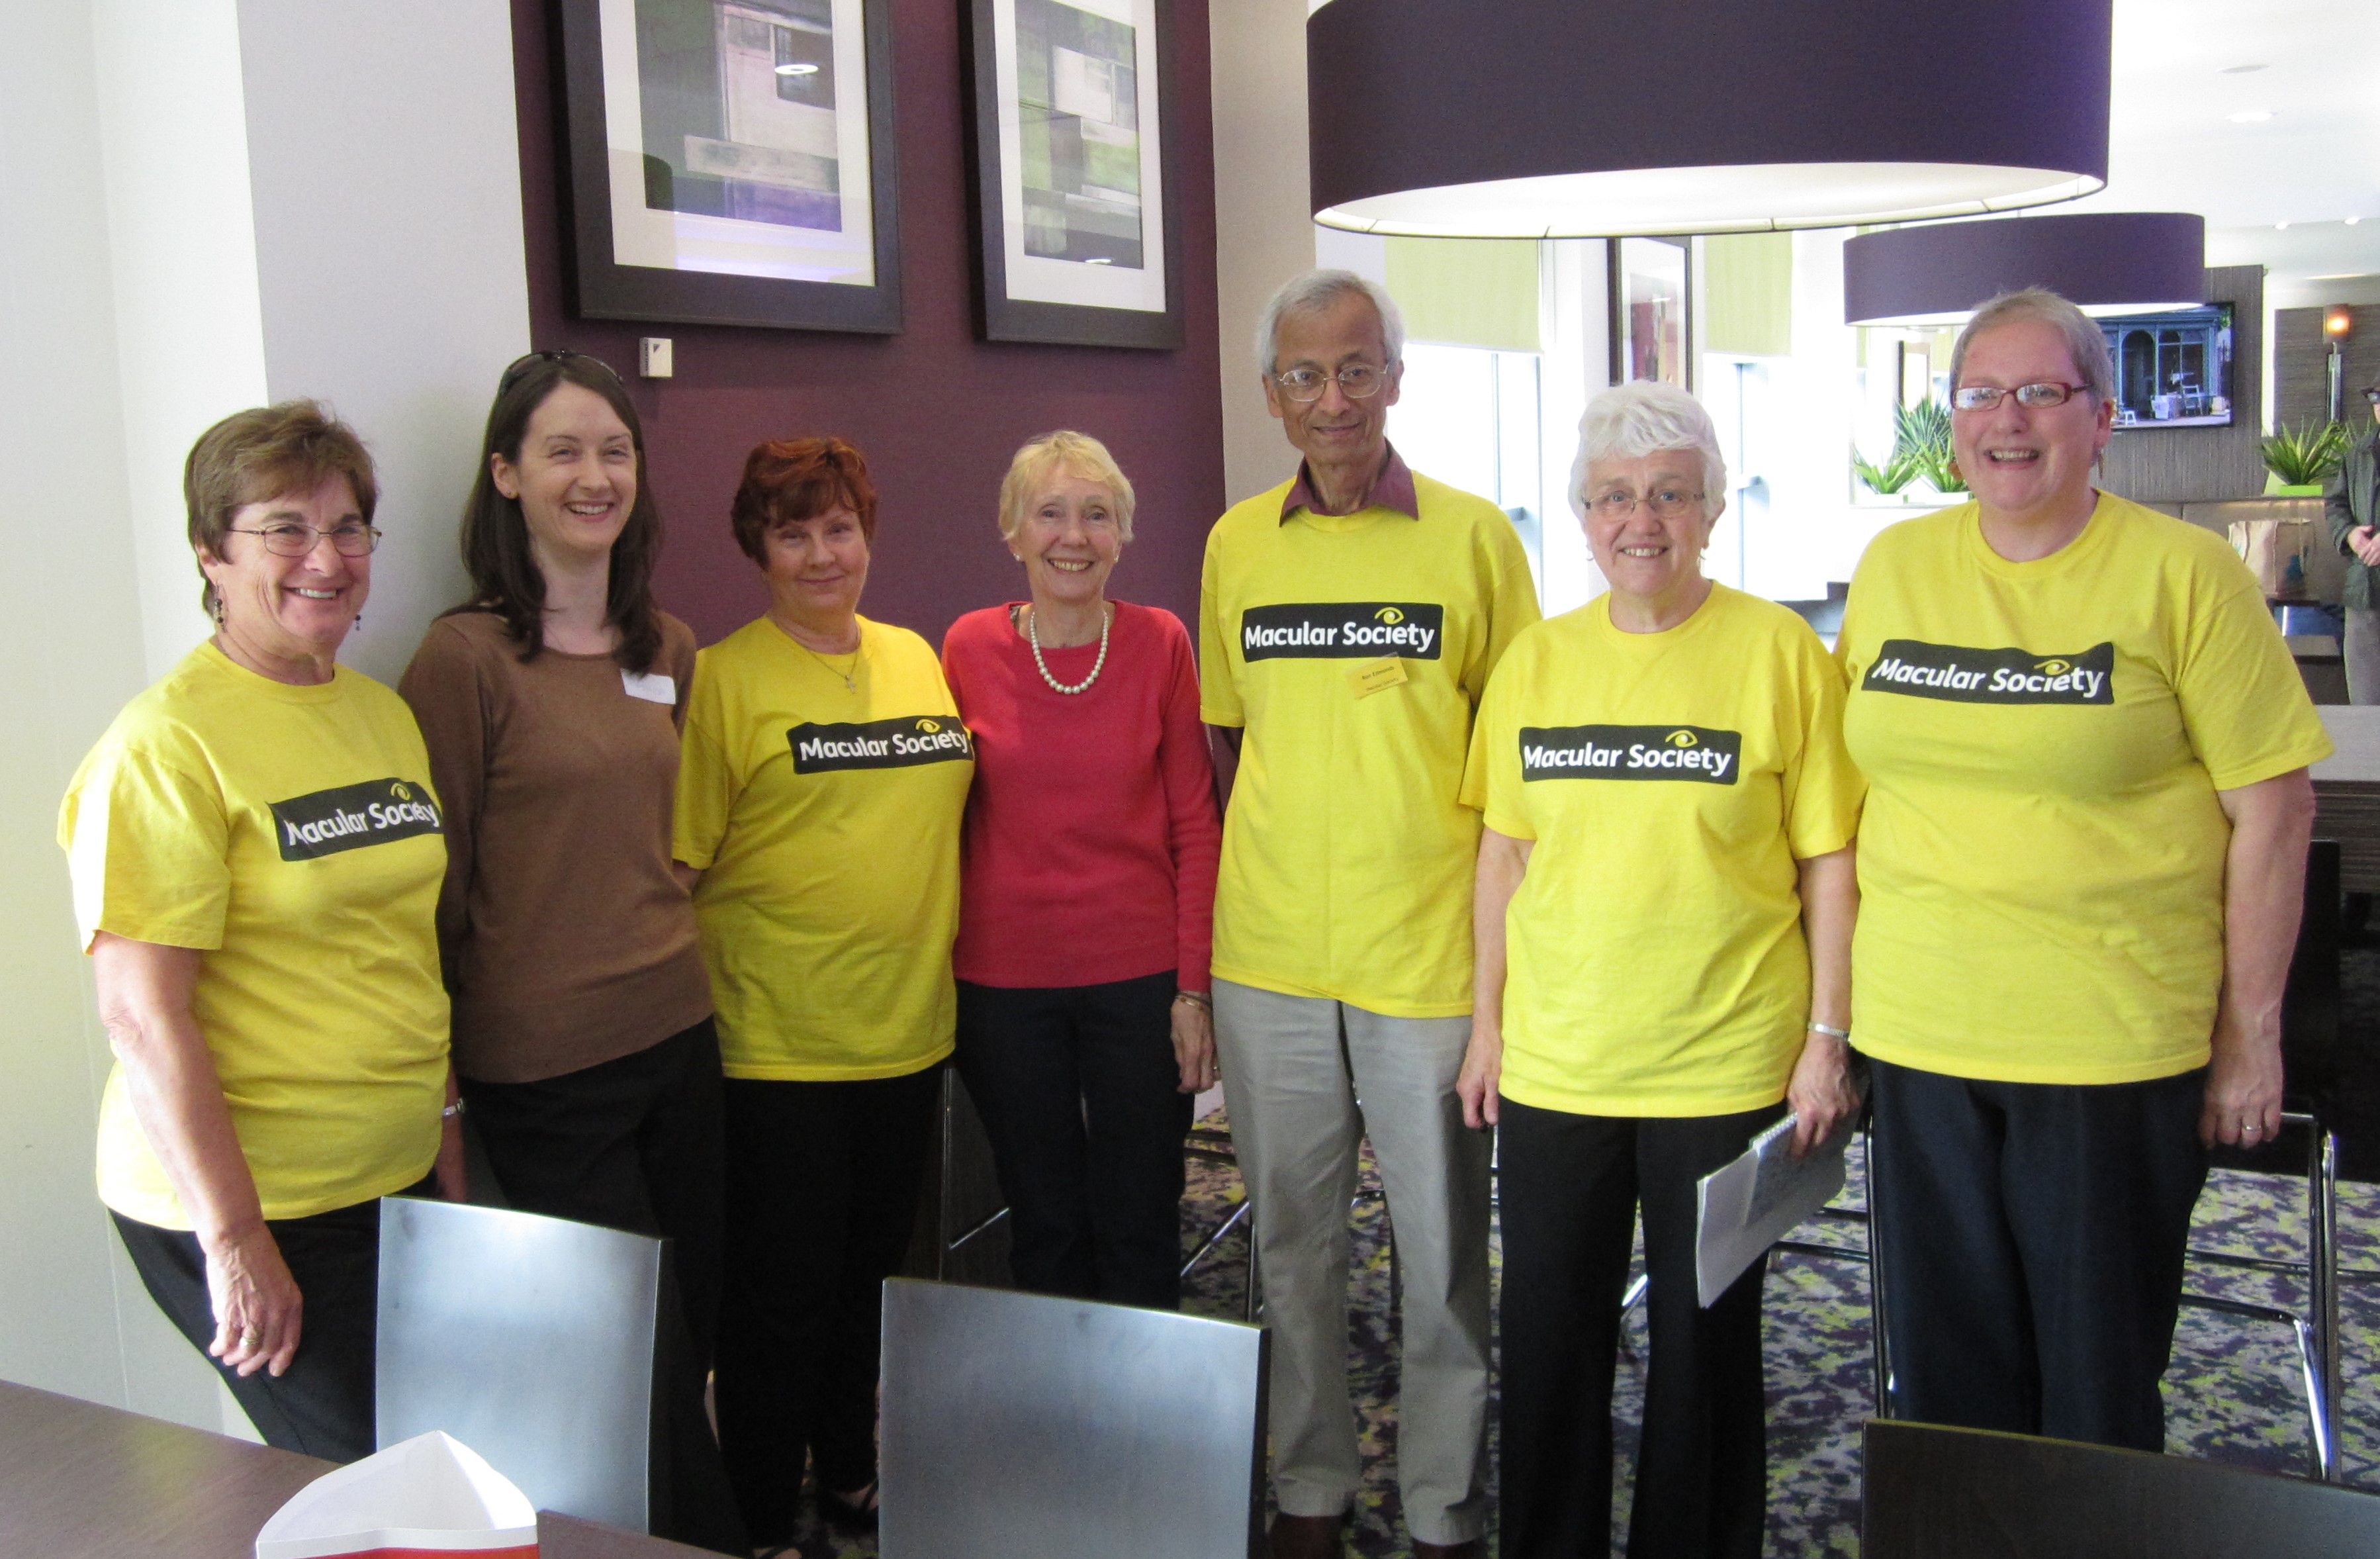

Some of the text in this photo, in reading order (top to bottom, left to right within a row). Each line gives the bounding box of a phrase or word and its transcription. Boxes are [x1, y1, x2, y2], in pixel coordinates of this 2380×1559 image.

[1245, 621, 1435, 653] Macular Society
[1872, 659, 2105, 698] Macular Society
[799, 729, 968, 761] Macular Society
[1524, 742, 1732, 777] Macular Society
[369, 802, 440, 829] Society
